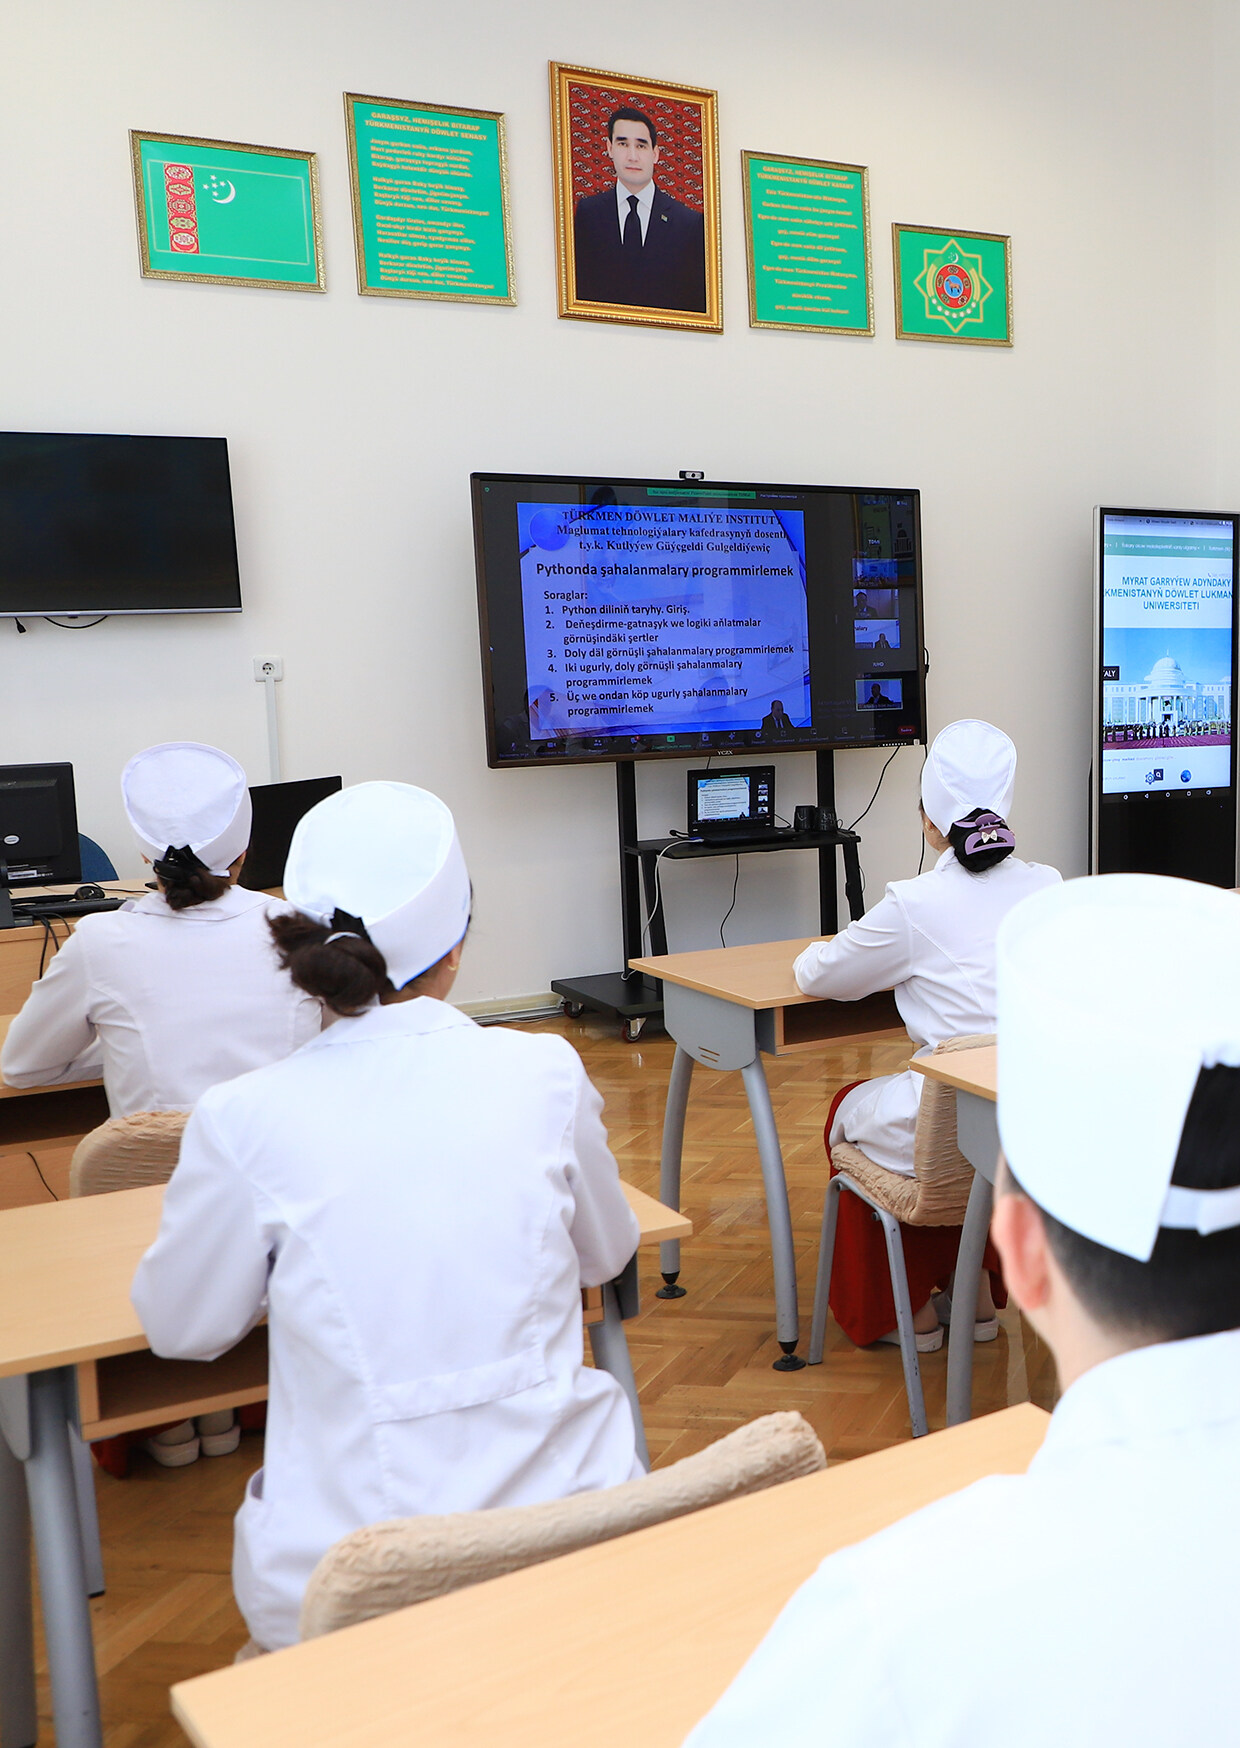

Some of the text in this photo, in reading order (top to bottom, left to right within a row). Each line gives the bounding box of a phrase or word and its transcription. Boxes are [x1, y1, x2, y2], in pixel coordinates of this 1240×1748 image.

[562, 508, 622, 521] TÜRKMEN
[626, 510, 676, 522] DÖWLET
[678, 512, 722, 524] MALIÝE
[556, 525, 610, 536] Maglumat
[612, 526, 686, 538] tehnologiýalary
[690, 528, 752, 540] kafedrasynyň
[579, 541, 604, 552] t.y.k.
[606, 540, 654, 552] Kutlyýew
[536, 563, 794, 578] Pythonda şahalanmalary programmirlemek
[1122, 576, 1231, 588] MYRAT GARRYÝEW ADYNDAKY
[544, 590, 588, 602] Soraglar:
[545, 604, 690, 616] 1. Python diliniň taryhy. Giriş.
[1143, 601, 1200, 610] UNIWERSITETI
[546, 620, 554, 629] 2.
[686, 618, 711, 630] logiki
[713, 618, 762, 628] aňlatmalar
[564, 634, 658, 645] görnüşindäki şertler
[547, 644, 794, 659] 3. Doly däl görnüşli şahalanmalary programmirlemek
[548, 660, 742, 674] 4. Iki ugurly, doly görnüşli şahalanmalary
[566, 676, 652, 688] programmirlemek
[550, 693, 559, 702] 5.
[567, 691, 580, 702] Üç
[599, 690, 628, 700] ondan
[632, 690, 648, 701] köp
[652, 689, 680, 700] ugurly
[682, 687, 748, 699] şahalanmalary
[568, 704, 654, 717] programmirlemek
